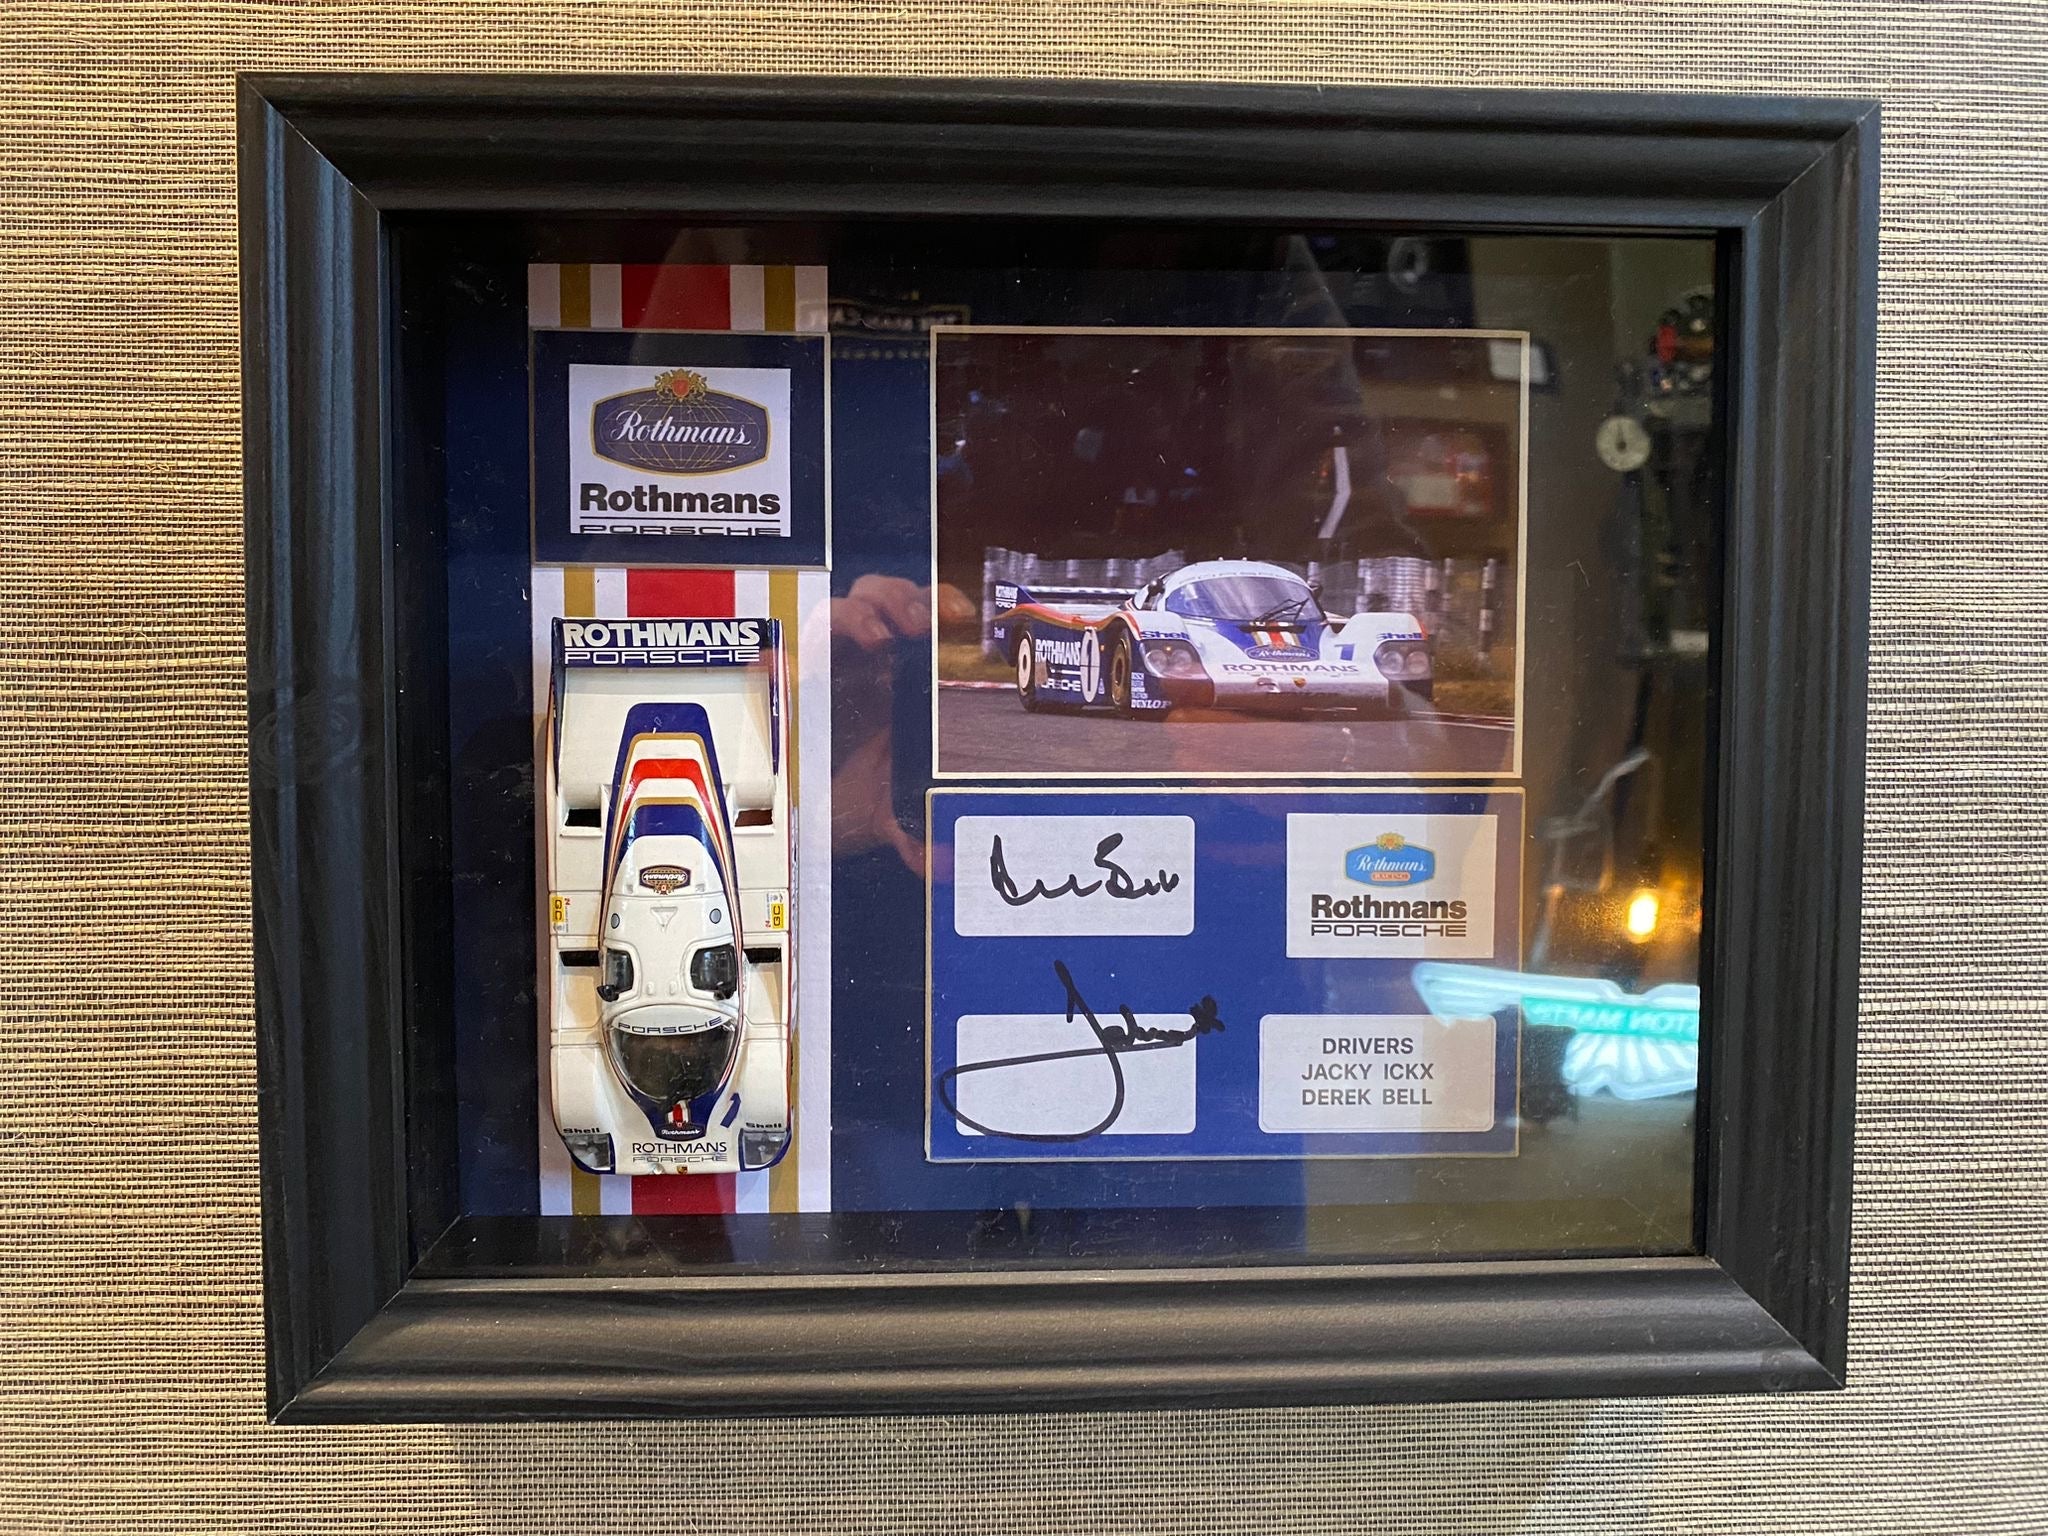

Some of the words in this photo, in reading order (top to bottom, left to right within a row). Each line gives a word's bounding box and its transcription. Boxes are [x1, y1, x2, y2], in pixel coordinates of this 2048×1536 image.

[610, 409, 751, 444] Rothmans
[580, 483, 781, 515] Rothmans
[579, 523, 781, 536] PORSCHE
[562, 620, 761, 647] ROTHMANS
[1140, 630, 1190, 641] Shell
[564, 649, 760, 665] PORSCHE
[1034, 638, 1082, 667] ROTHMANS
[1333, 643, 1356, 661] 1
[1222, 663, 1359, 673] ROTHMANS
[1131, 699, 1172, 709] DUNLOP
[1354, 854, 1428, 872] Rothmans
[1311, 894, 1467, 919] Rothmans
[1311, 924, 1467, 937] PORSCHE
[618, 1016, 721, 1034] PORSCHE
[1322, 1037, 1414, 1055] DRIVERS
[1301, 1063, 1372, 1080] JACKY
[1383, 1063, 1434, 1080] ICKX
[1302, 1088, 1372, 1105] DEREK
[1382, 1088, 1433, 1105] BELL
[719, 1092, 742, 1128] 1
[745, 1121, 782, 1129] Shell
[632, 1141, 727, 1154] ROTHMANS
[632, 1154, 728, 1163] PORSCHE
